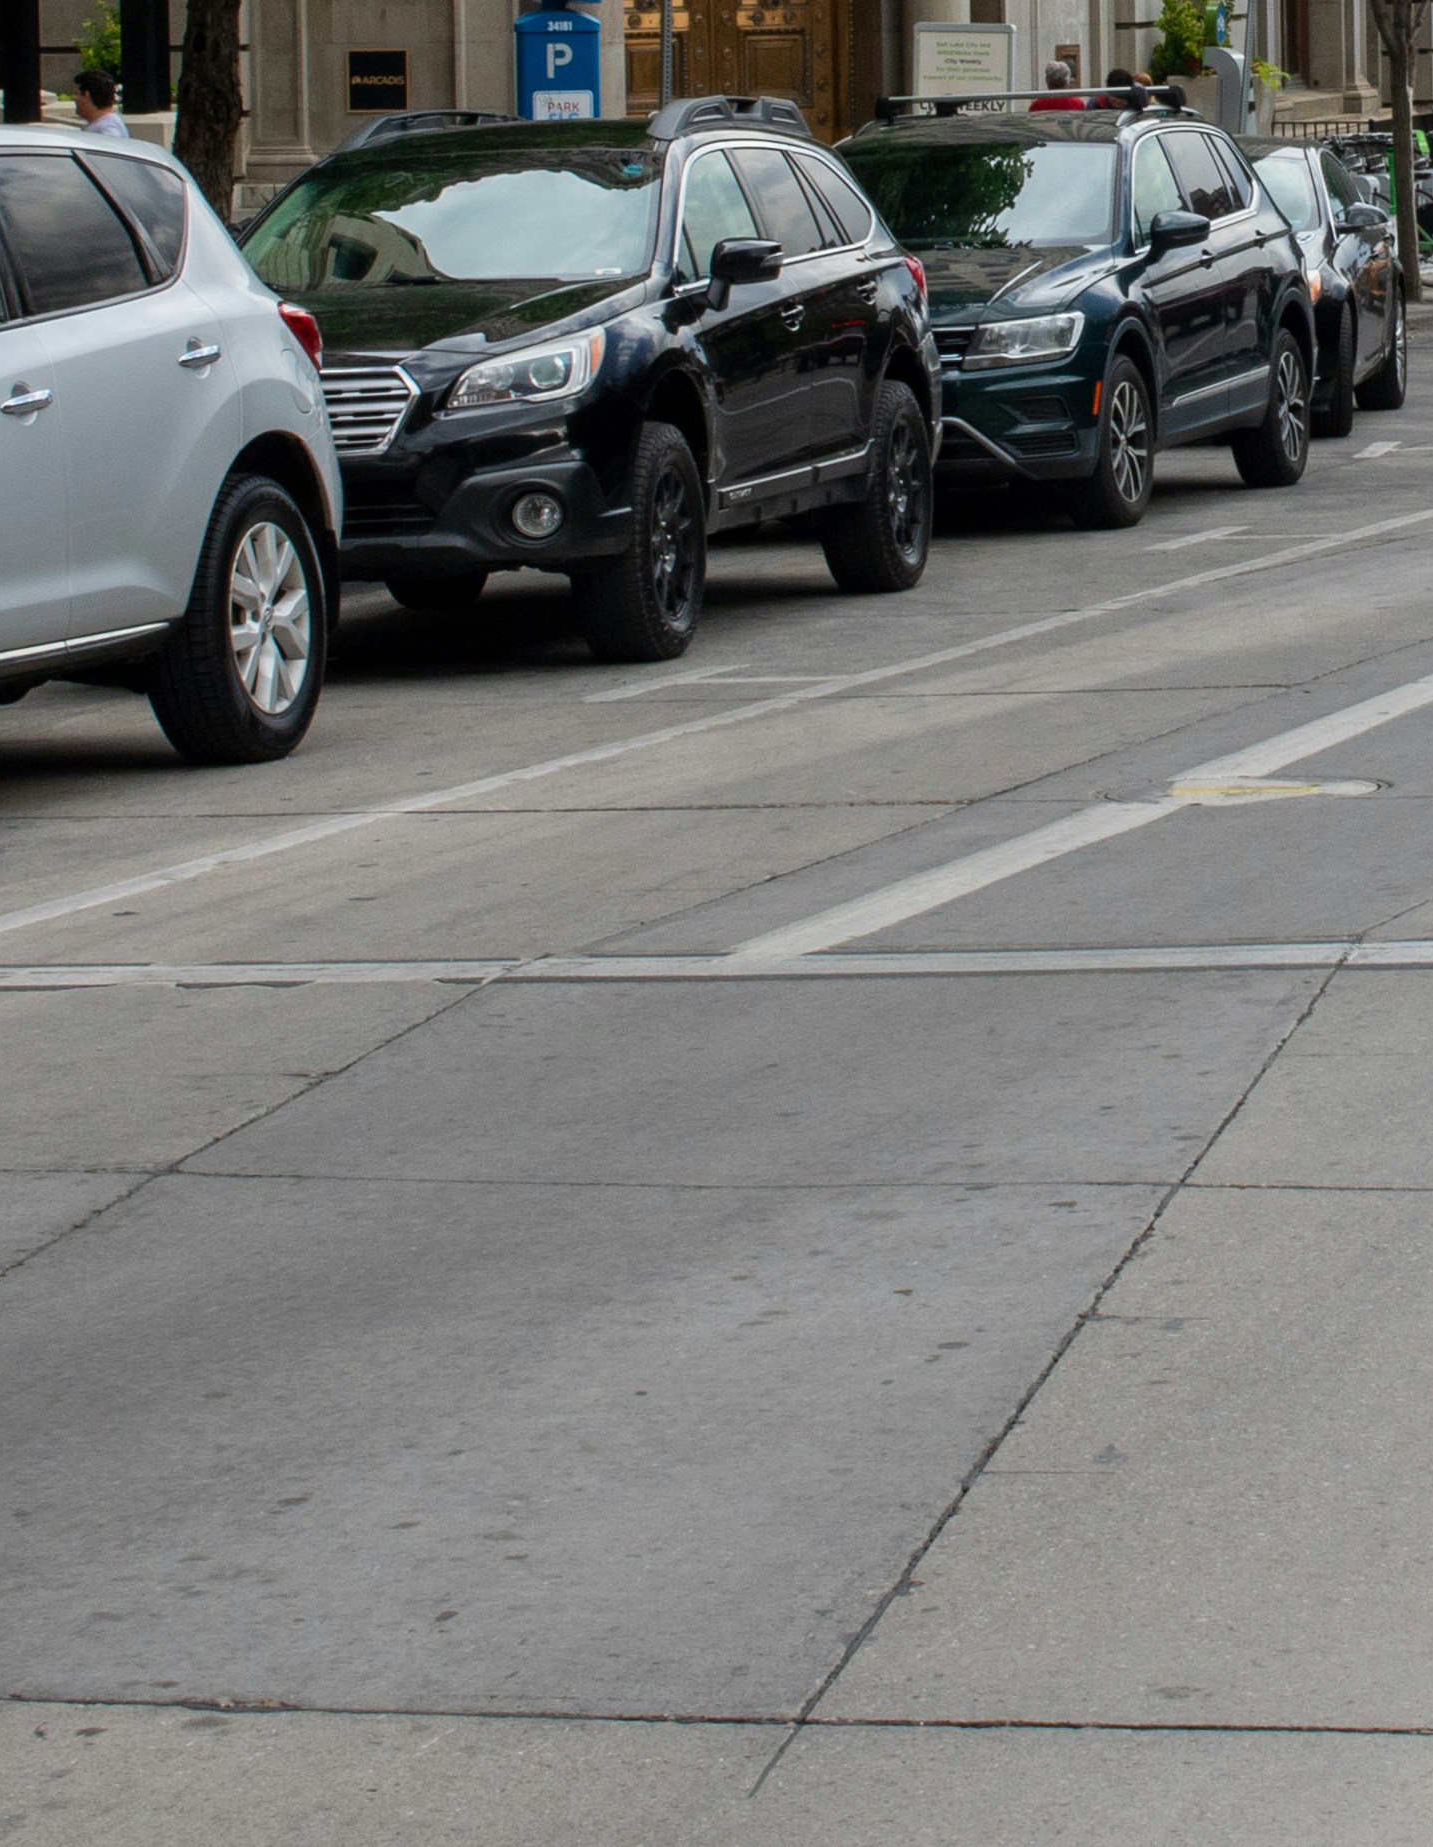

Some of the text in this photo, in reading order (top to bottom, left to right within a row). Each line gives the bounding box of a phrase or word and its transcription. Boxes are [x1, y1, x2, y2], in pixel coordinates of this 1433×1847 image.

[547, 43, 573, 78] P
[362, 76, 404, 85] ARCADIS
[548, 102, 579, 112] PARK
